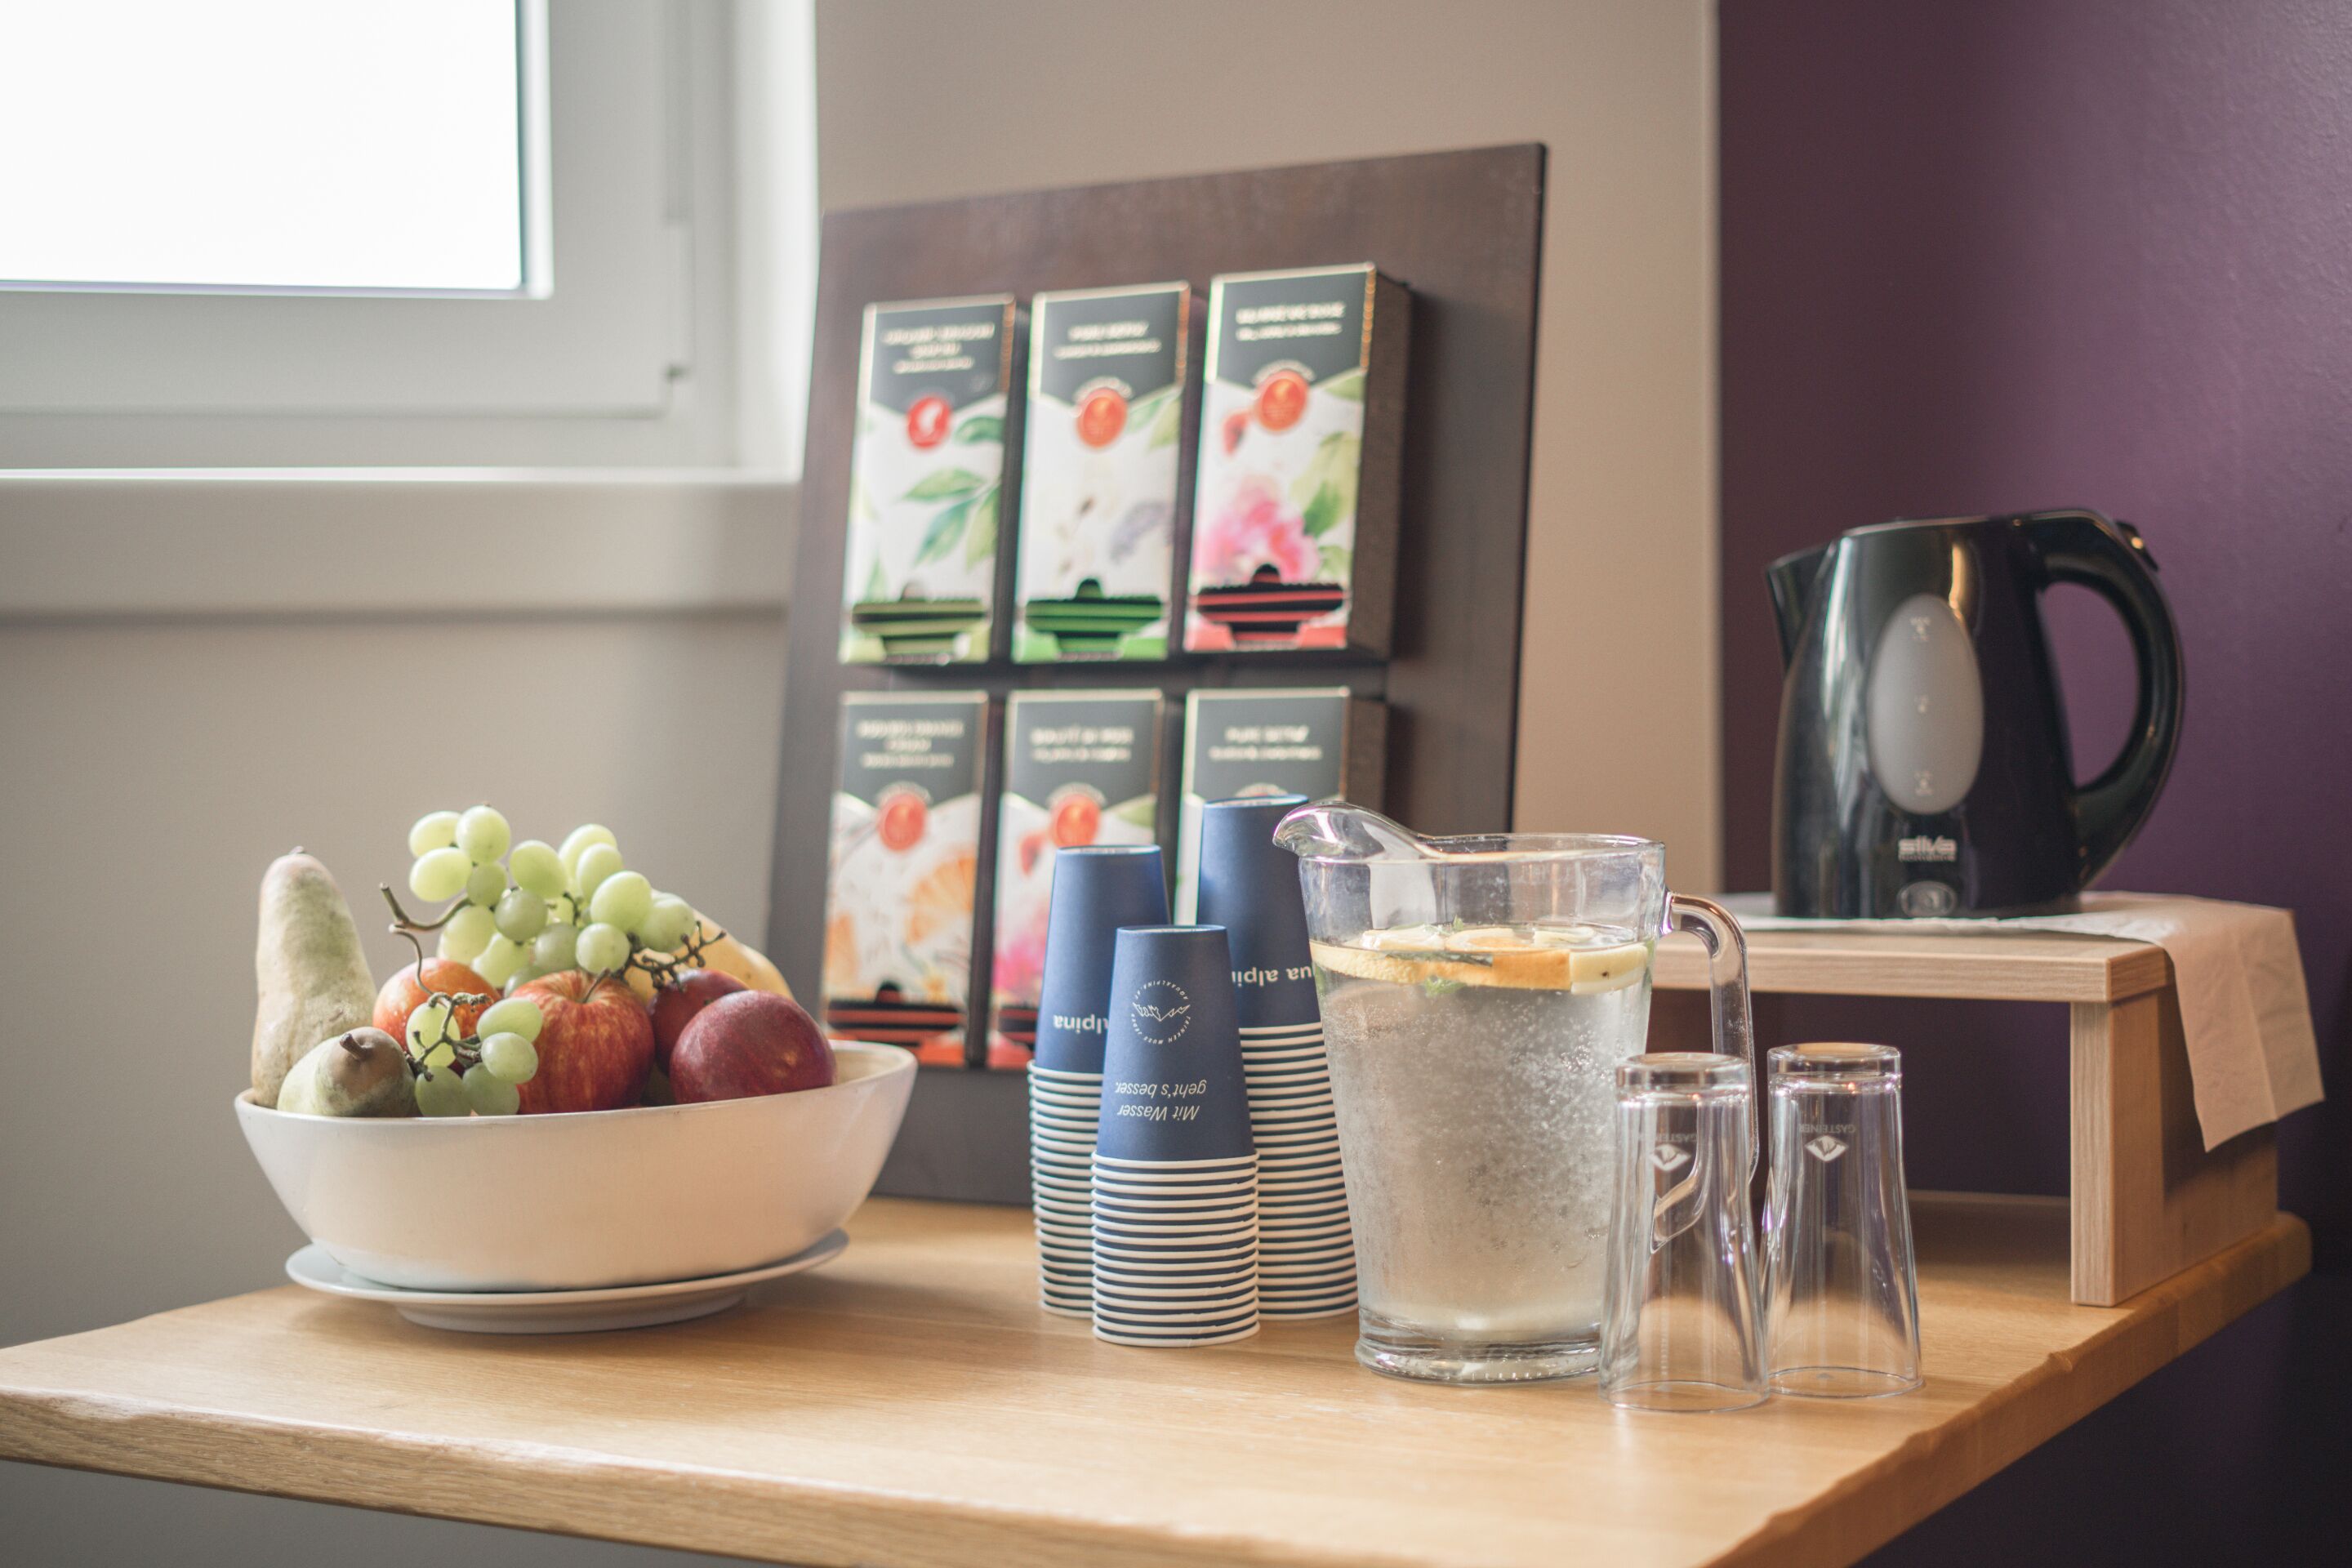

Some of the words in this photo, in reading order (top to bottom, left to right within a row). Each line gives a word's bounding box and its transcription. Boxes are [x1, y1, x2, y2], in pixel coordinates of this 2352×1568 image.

[1898, 835, 1957, 854] silva
[1231, 966, 1279, 987] alpi
[1285, 965, 1312, 981] ua
[1167, 1015, 1192, 1044] TRINKEN
[1143, 1036, 1164, 1045] MUSS
[1115, 1081, 1157, 1098] besser.
[1160, 1079, 1207, 1098] geht's
[1116, 1104, 1168, 1121] Wasser
[1172, 1105, 1200, 1121] Mit
[1799, 1123, 1856, 1134] GASTEINER
